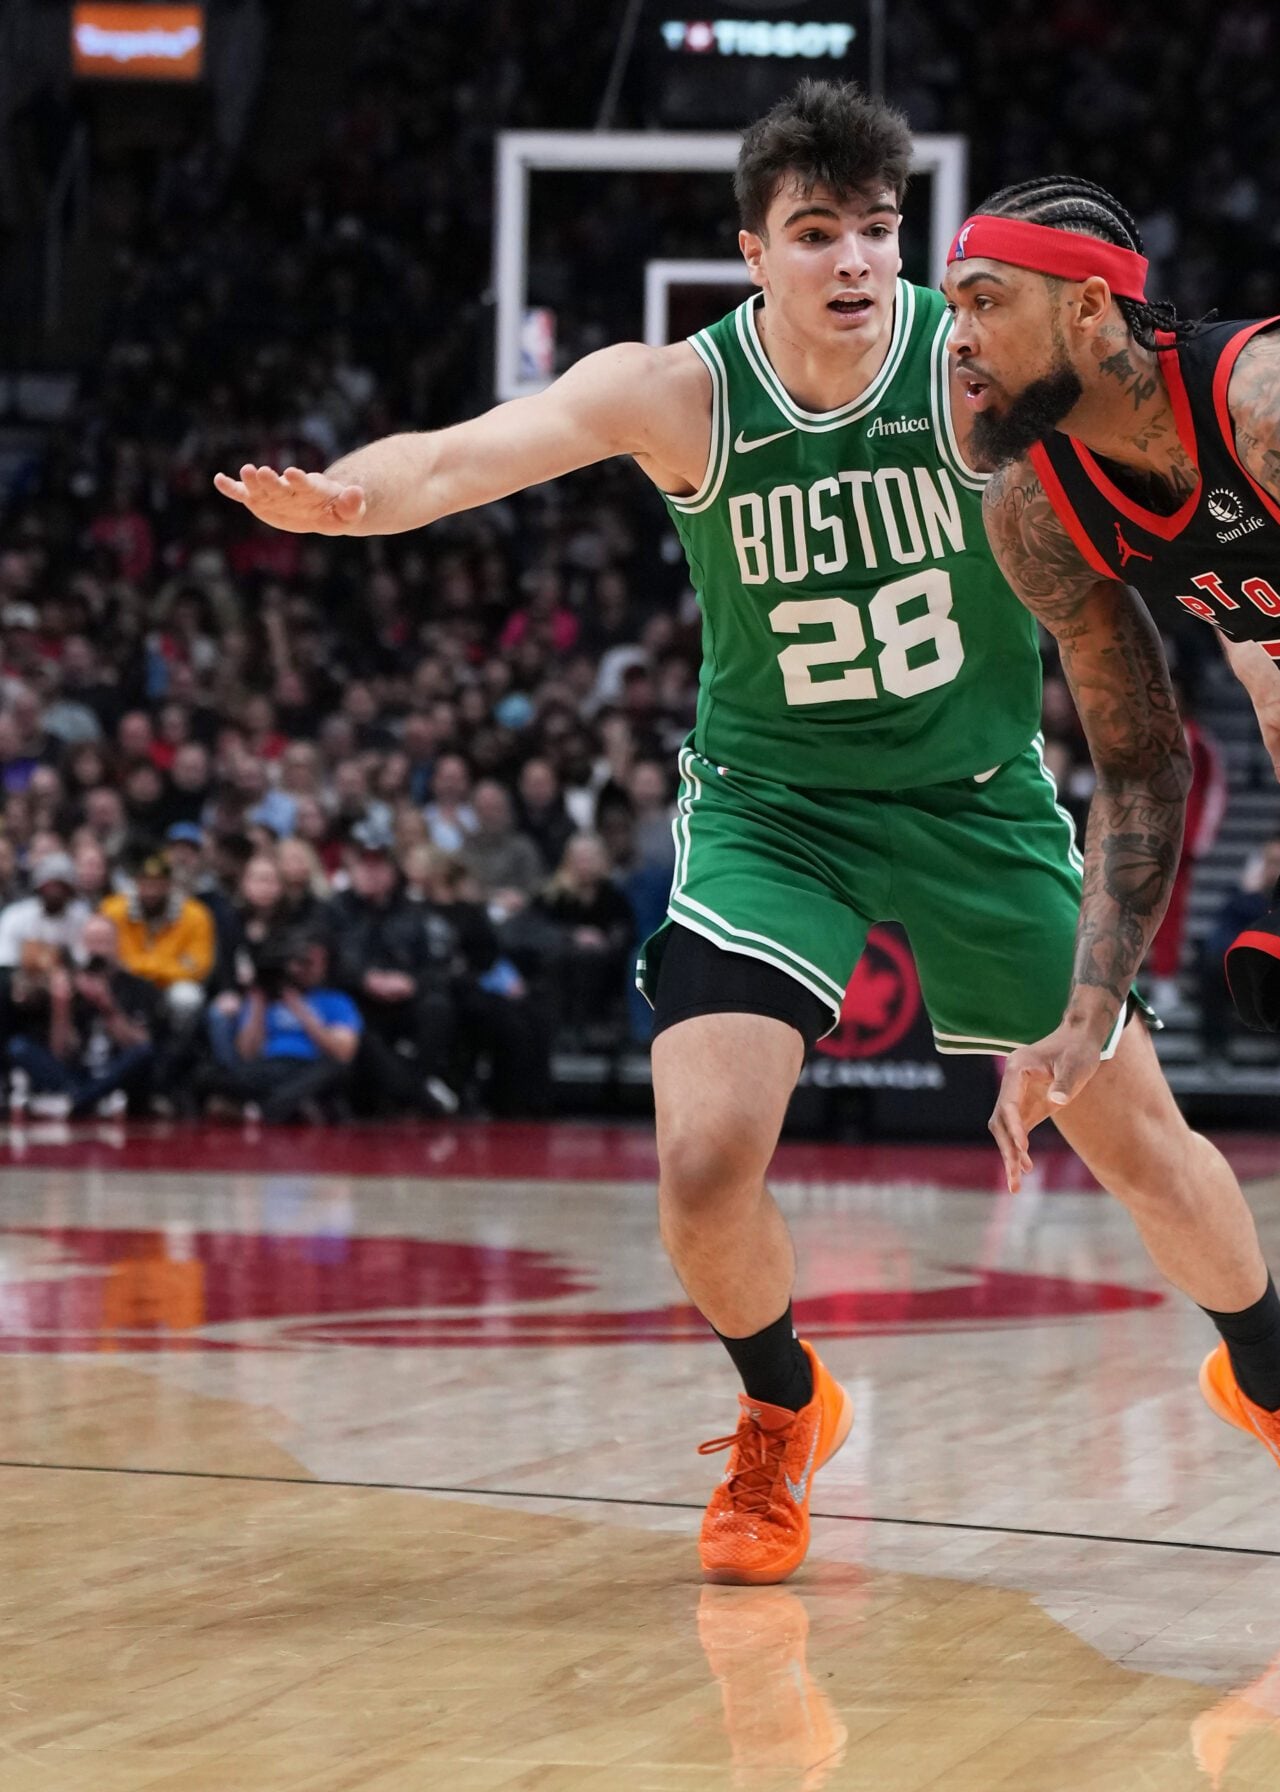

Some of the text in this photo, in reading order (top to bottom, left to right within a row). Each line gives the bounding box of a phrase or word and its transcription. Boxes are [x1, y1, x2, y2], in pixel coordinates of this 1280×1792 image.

[713, 20, 856, 58] TISSOT
[867, 415, 930, 438] Amica
[728, 467, 966, 585] BOSTON
[1216, 516, 1265, 544] Sun Life
[768, 568, 965, 705] 28
